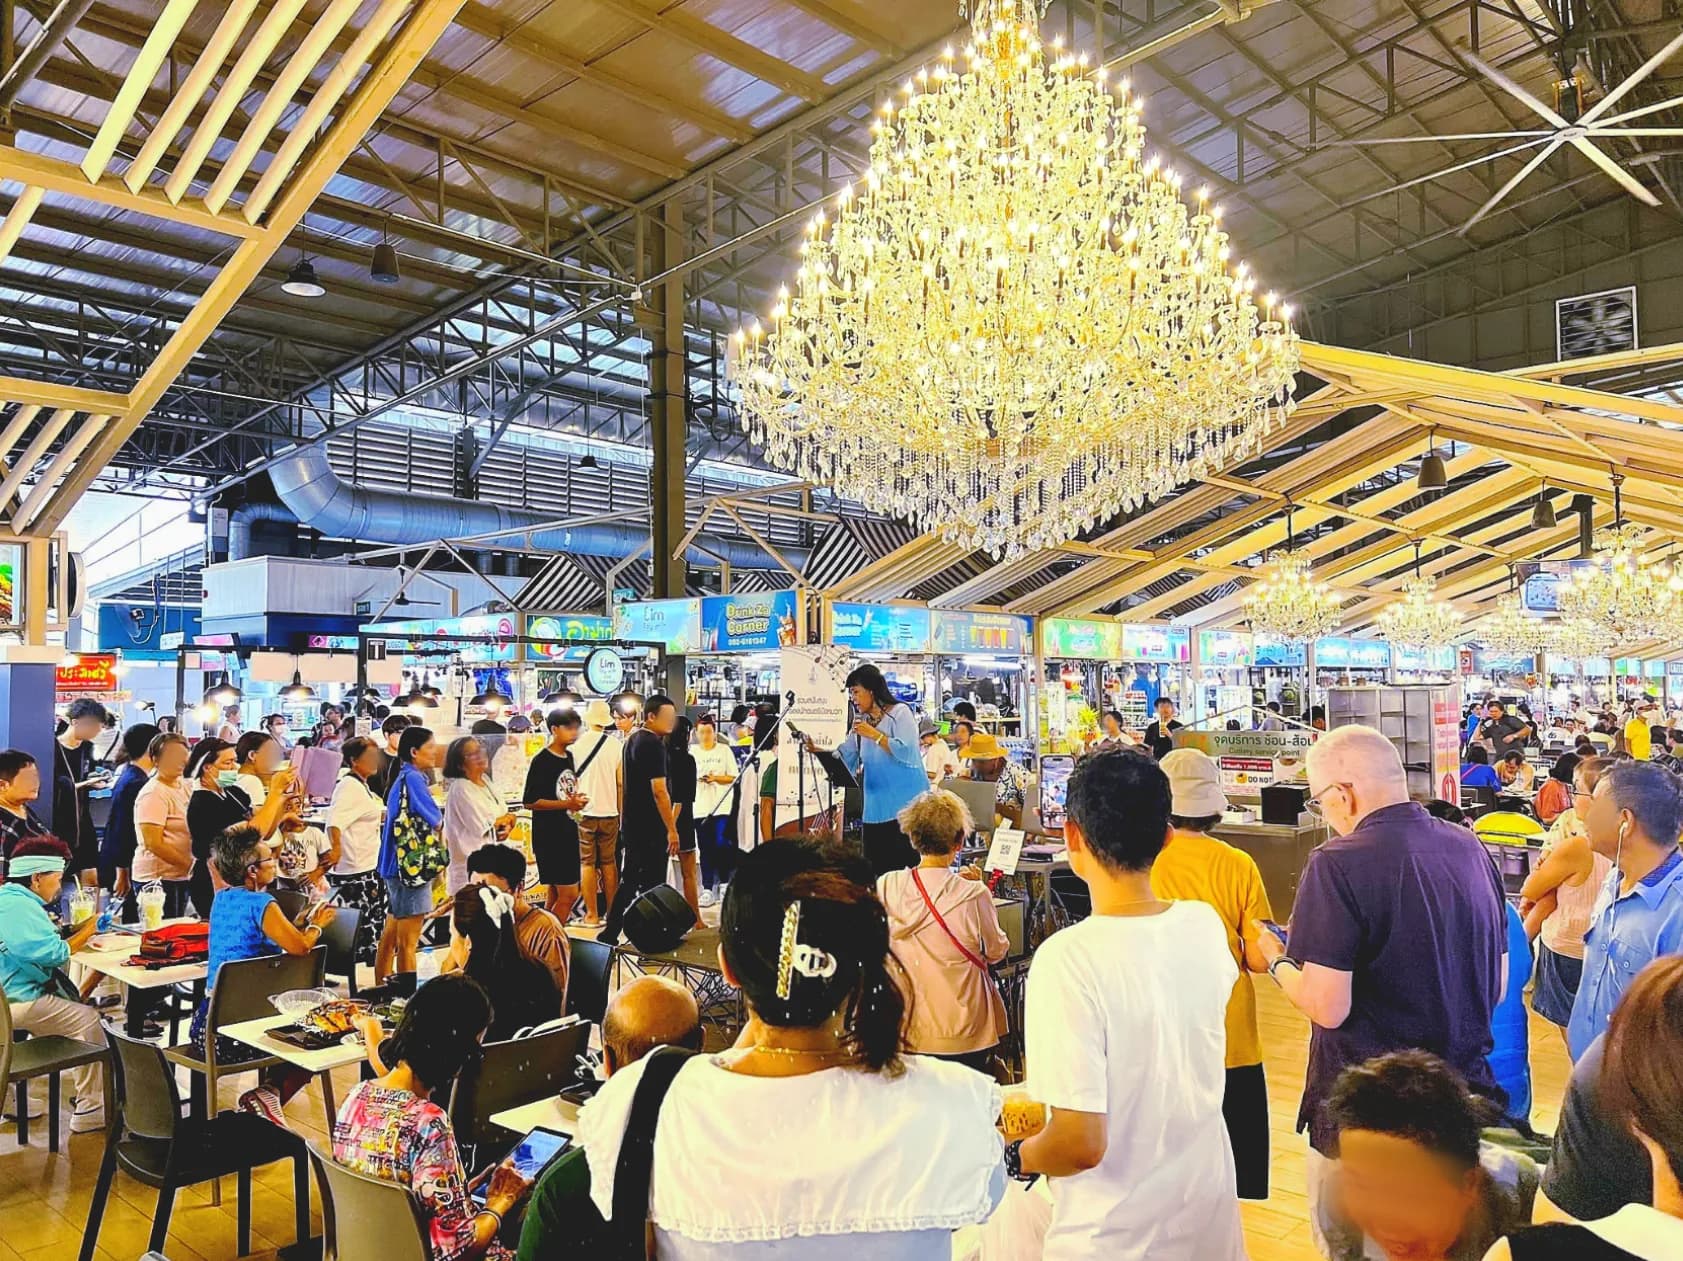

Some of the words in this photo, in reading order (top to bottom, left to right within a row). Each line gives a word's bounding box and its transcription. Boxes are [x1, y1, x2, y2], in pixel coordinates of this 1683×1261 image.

[727, 619, 769, 635] Corner
[1214, 735, 1261, 747] จุดบริการ
[1282, 749, 1300, 757] point
